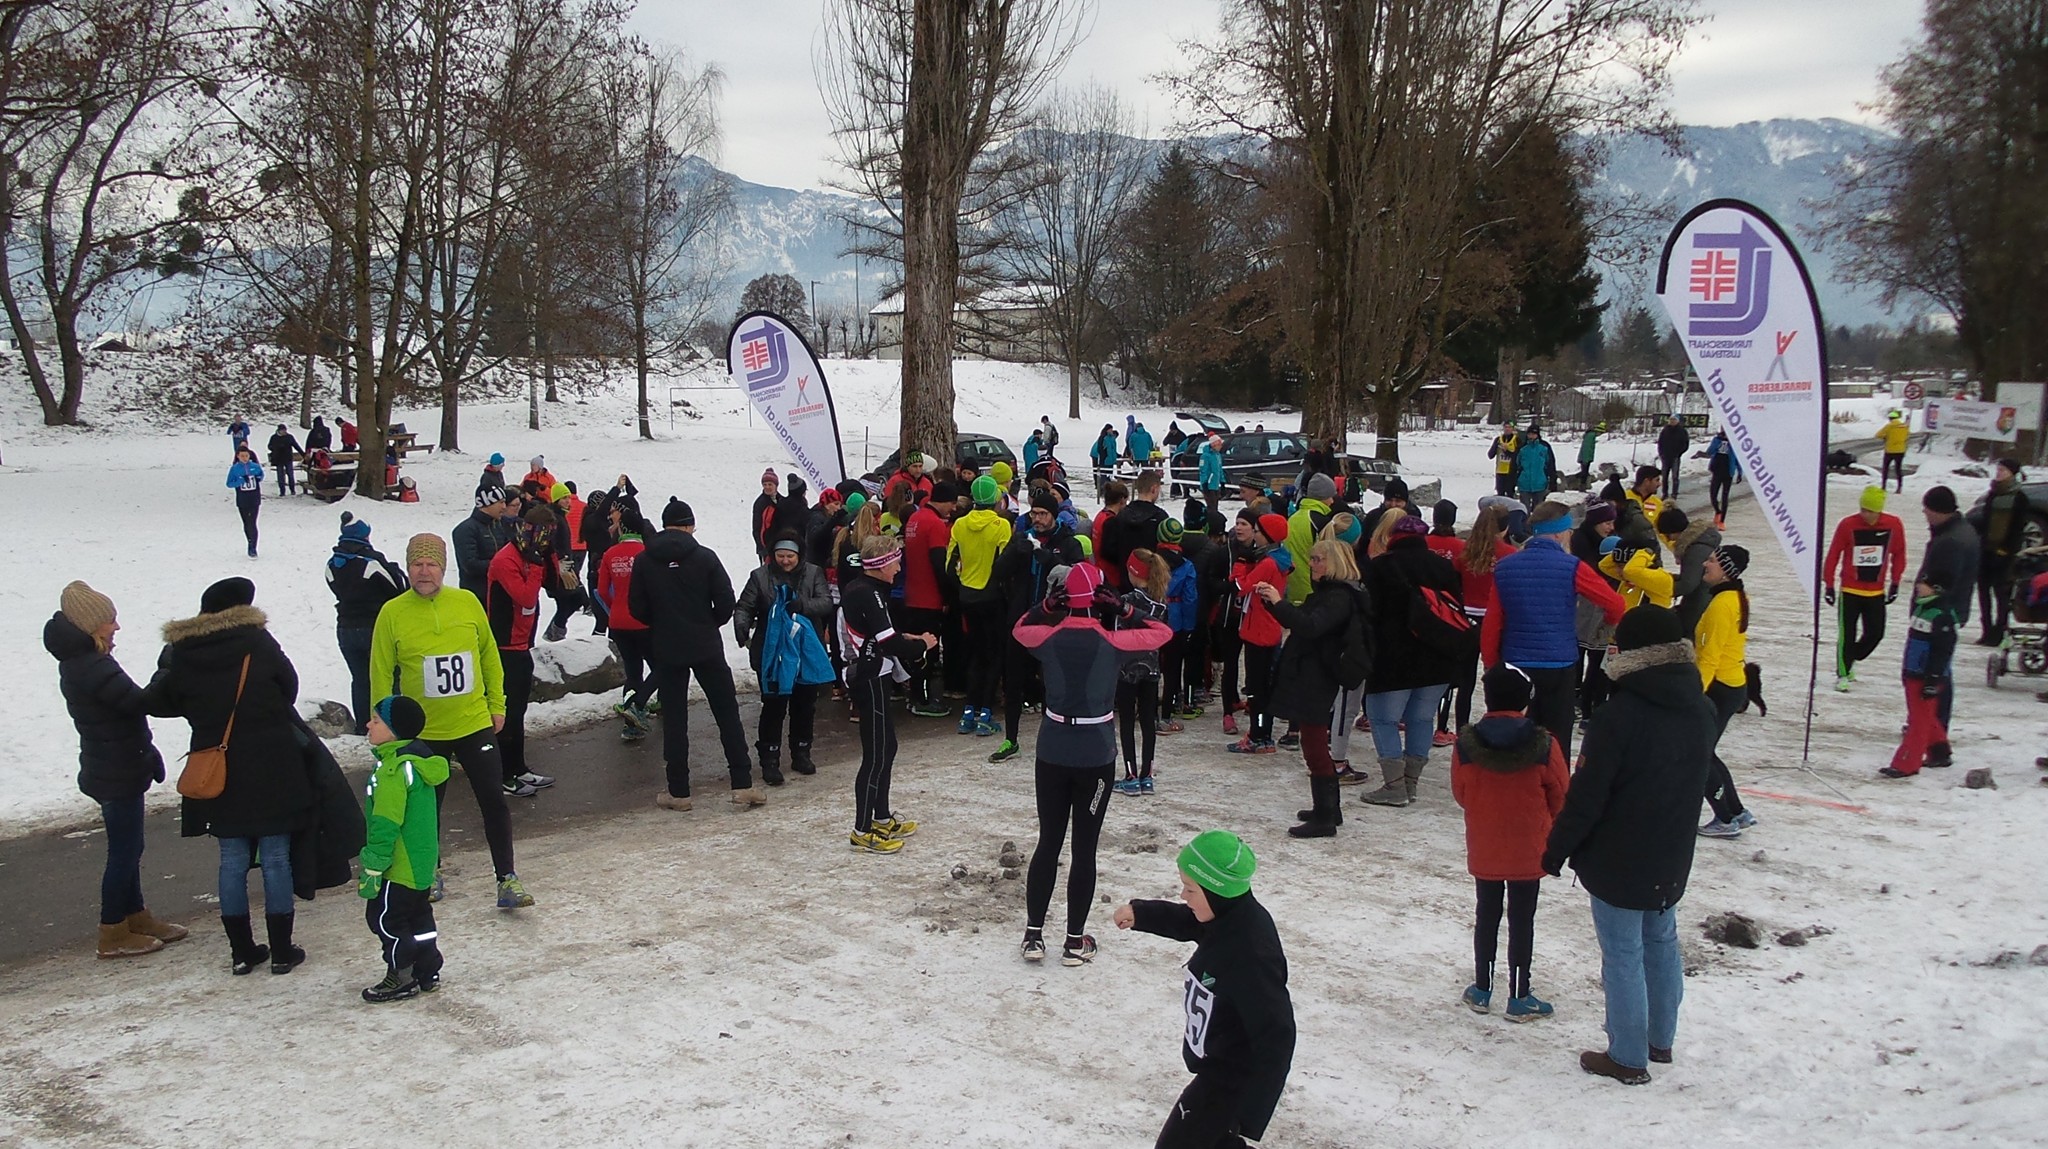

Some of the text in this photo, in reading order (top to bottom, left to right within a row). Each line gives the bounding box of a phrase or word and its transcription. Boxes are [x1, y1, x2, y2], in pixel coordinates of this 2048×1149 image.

[1858, 556, 1878, 564] 340
[435, 655, 465, 695] 58
[1184, 977, 1209, 1046] 15
